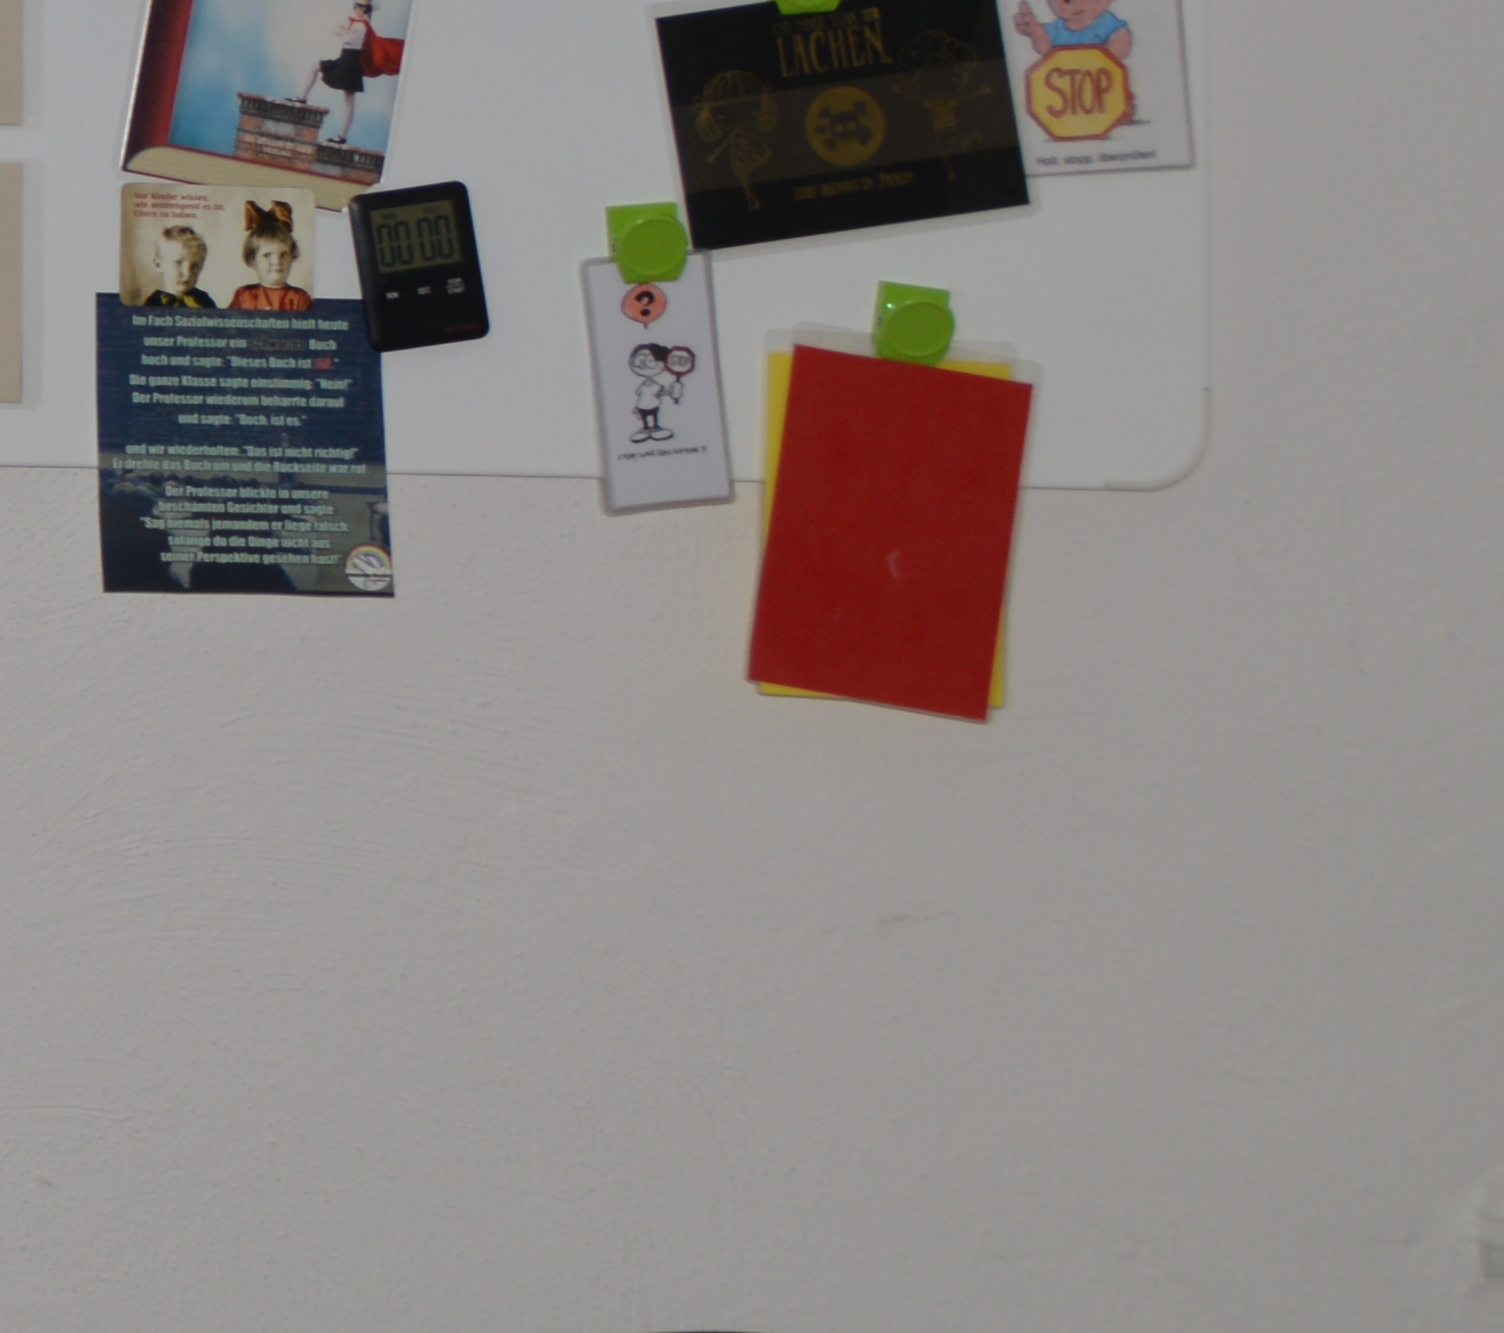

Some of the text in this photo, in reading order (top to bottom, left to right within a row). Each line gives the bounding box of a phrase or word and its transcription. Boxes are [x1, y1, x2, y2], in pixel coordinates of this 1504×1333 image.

[1044, 66, 1113, 118] STOP
[634, 290, 655, 317] ?
[132, 314, 349, 330] Im Fach Sozialwissenschaften hielt heute
[143, 335, 337, 350] unser Professor ein Buch
[141, 354, 168, 365] hoch
[170, 355, 191, 366] und
[269, 356, 296, 368] Buch
[297, 358, 312, 369] ist
[129, 373, 147, 385] Die
[148, 376, 180, 387] ganze
[181, 375, 218, 387] Klasse
[218, 377, 249, 389] sagte
[132, 392, 345, 408] Der Professor wiederum beharrte darauf
[178, 413, 199, 424] und
[270, 415, 284, 426] ist
[125, 443, 147, 454] und
[148, 444, 165, 454] wir
[269, 446, 283, 457] ist
[285, 446, 312, 457] nicht
[112, 457, 124, 469] Er
[124, 459, 160, 469] drehte
[161, 459, 182, 470] das
[183, 459, 211, 470] Buch
[212, 461, 230, 471] um
[231, 461, 252, 471] und
[254, 461, 272, 472] die
[328, 464, 348, 473] war
[165, 485, 329, 500] Der Professor blickte in unsere
[227, 501, 278, 514] Gesichter
[280, 503, 302, 514] und
[166, 518, 210, 529] niemals
[212, 518, 269, 531] jemandem
[271, 521, 283, 531] er
[284, 520, 312, 532] liege
[168, 535, 332, 549] solange du die Dinge nicht aus
[160, 552, 196, 562] seiner
[196, 551, 261, 564] Perspektive
[262, 553, 310, 565] gesehen
